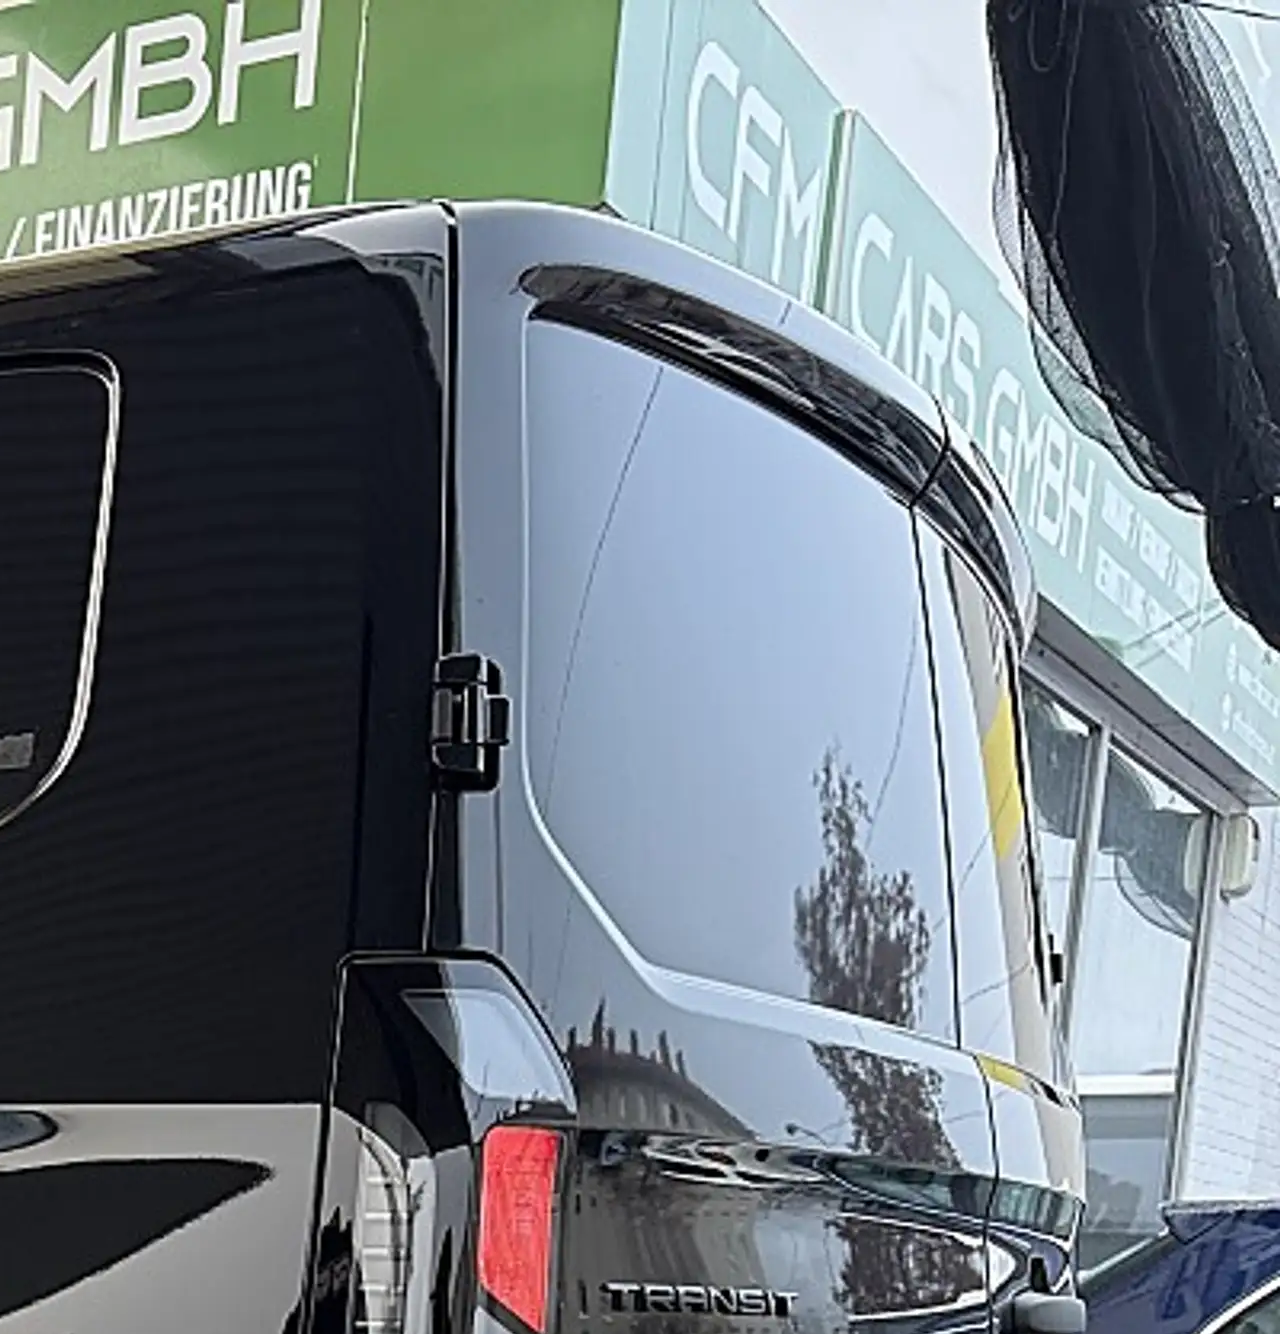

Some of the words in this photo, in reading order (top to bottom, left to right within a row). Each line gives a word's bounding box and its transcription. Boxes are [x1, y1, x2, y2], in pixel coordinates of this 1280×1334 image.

[688, 40, 823, 305] CFM
[851, 212, 983, 430] CARS
[986, 367, 1095, 574] GMBH
[604, 1282, 799, 1319] TRANSIT
